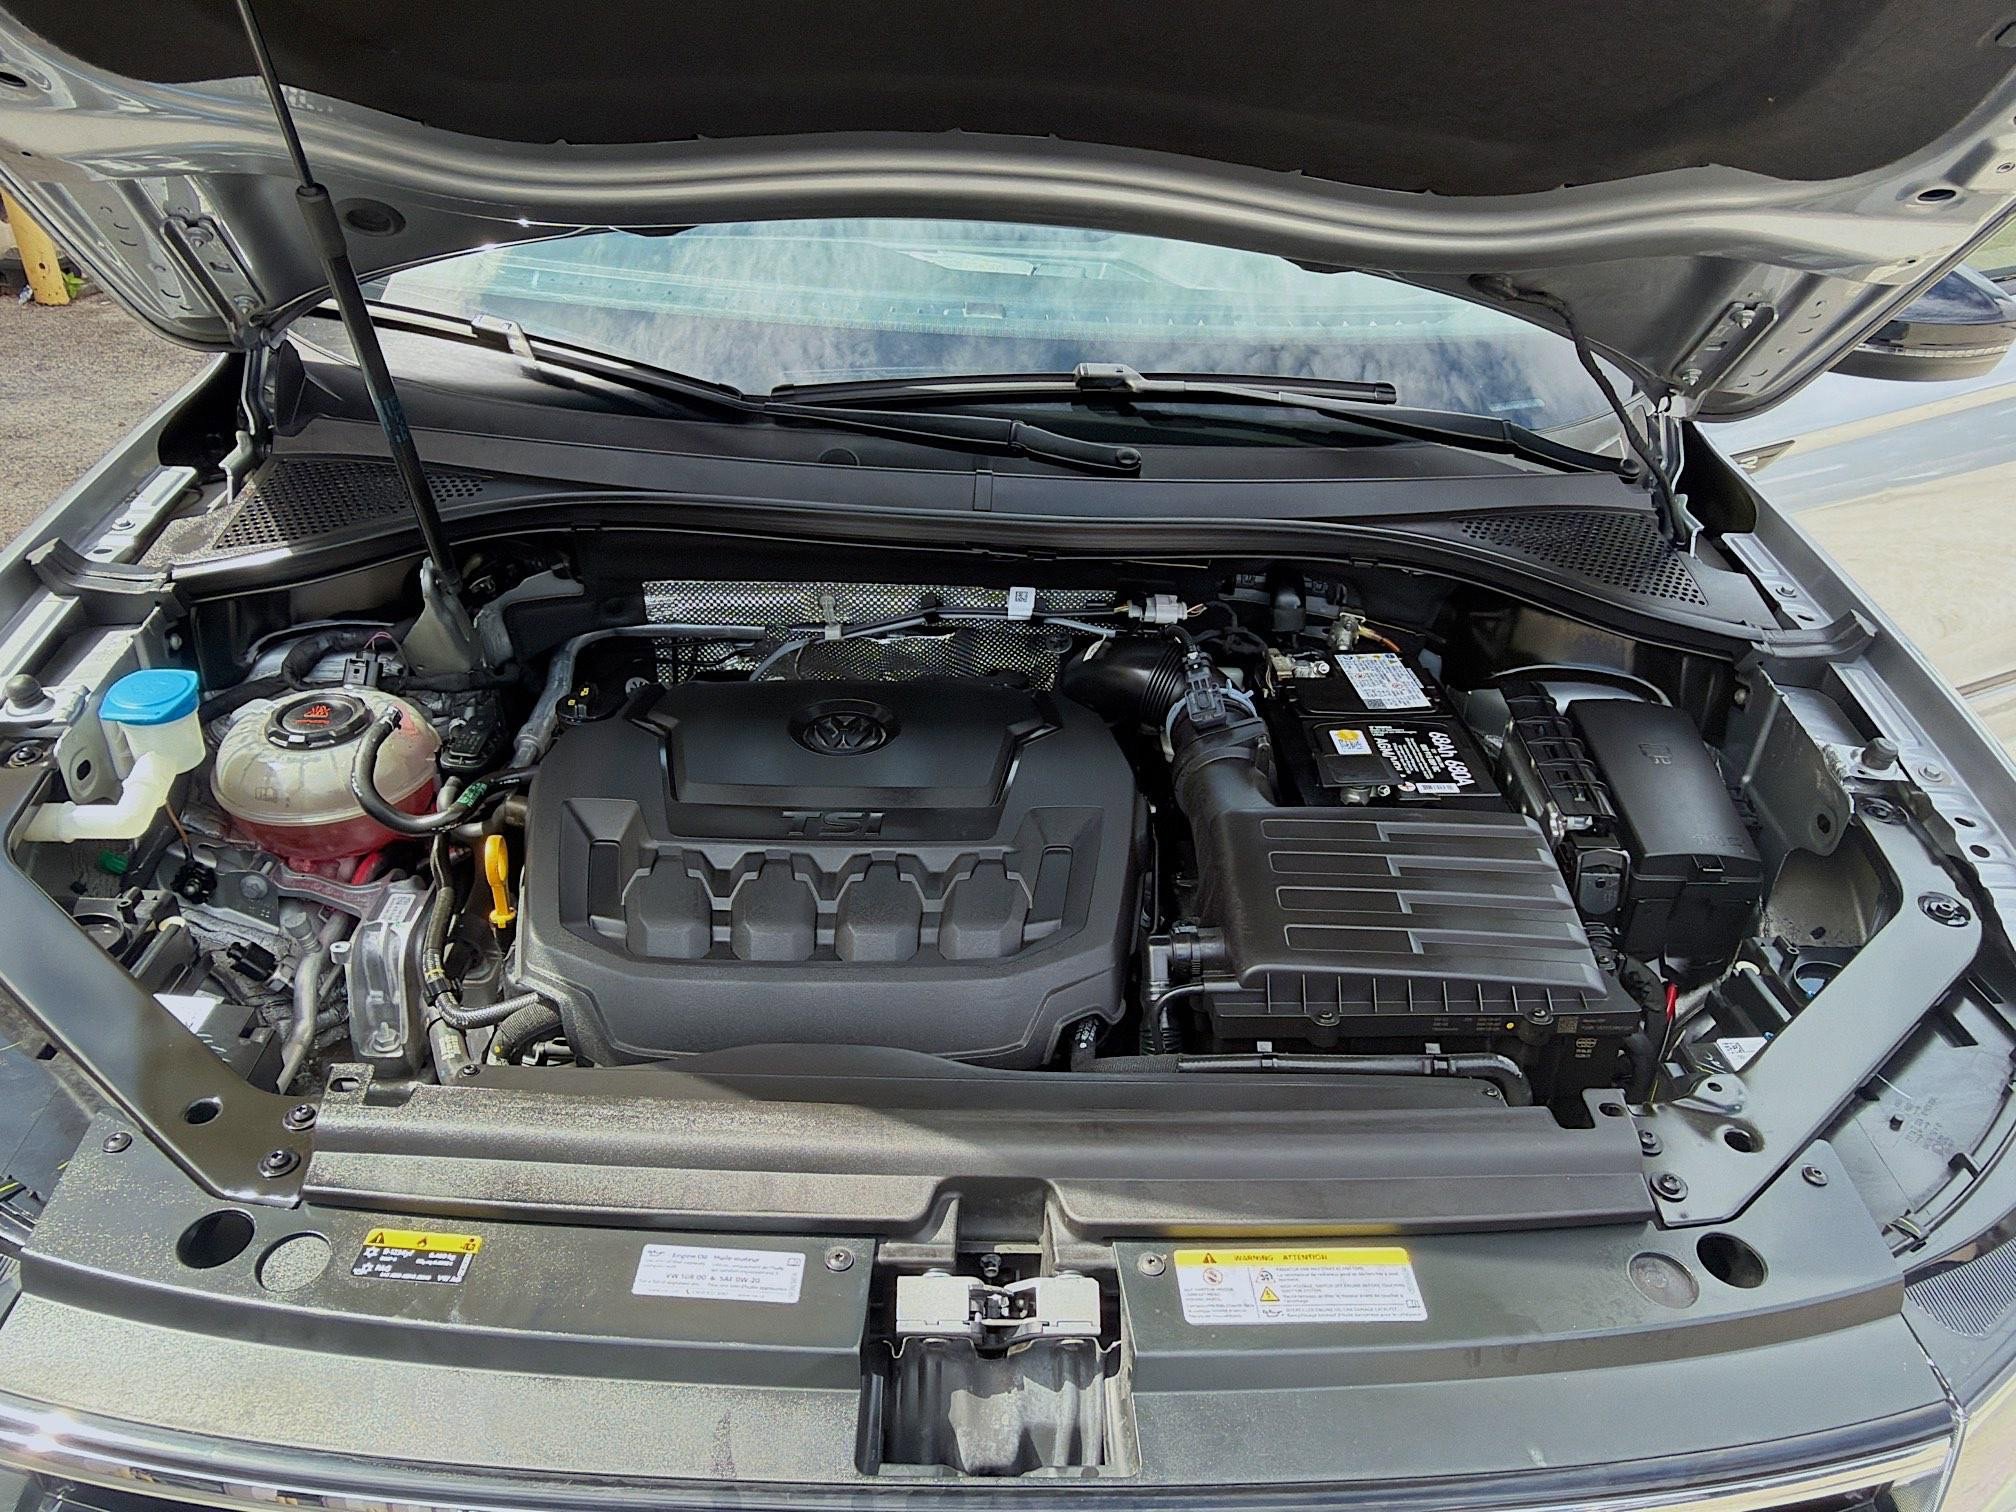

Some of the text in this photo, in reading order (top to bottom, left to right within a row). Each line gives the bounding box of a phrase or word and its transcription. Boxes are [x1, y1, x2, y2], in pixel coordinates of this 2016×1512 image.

[1428, 731, 1458, 758] 68Ah
[1444, 759, 1476, 787] 680A
[782, 810, 885, 836] TSI
[1233, 1253, 1329, 1262] WARNING ATTENTION
